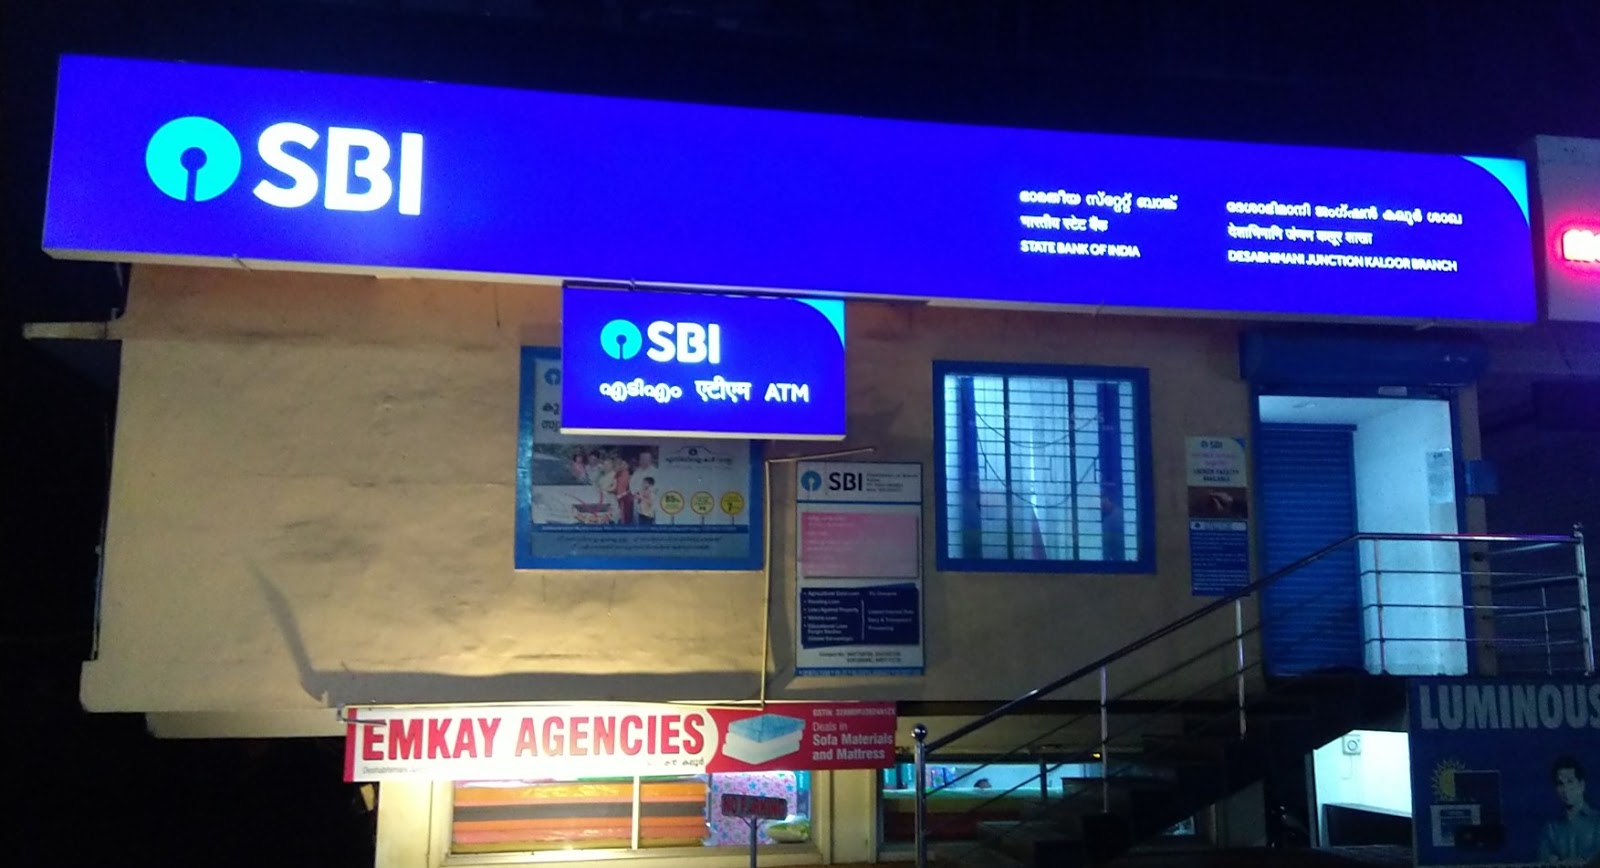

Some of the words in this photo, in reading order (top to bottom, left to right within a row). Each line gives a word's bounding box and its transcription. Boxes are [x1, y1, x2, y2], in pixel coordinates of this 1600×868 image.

[252, 122, 424, 216] SBI
[1019, 213, 1061, 230] भारतीय
[1062, 214, 1087, 231] स्टेट
[1020, 240, 1056, 254] STATE
[1056, 242, 1089, 256] BANK
[1089, 243, 1107, 256] OF
[1108, 244, 1141, 258] INDIA
[1227, 249, 1305, 266] DESABHIMANI
[1305, 252, 1364, 268] JUNCTION
[1364, 255, 1411, 270] KALOOR
[1411, 257, 1458, 273] BRANCH
[646, 320, 721, 365] SBI
[599, 378, 682, 403] എടിഎം
[694, 375, 752, 403] एटीएम
[764, 382, 810, 403] ATM
[829, 472, 862, 491] SBI
[812, 721, 837, 732] Deals
[839, 721, 848, 732] in
[362, 716, 502, 763] EMKAY
[514, 712, 705, 758] AGENCIES
[812, 733, 838, 746] Sofa
[841, 732, 893, 746] Materials
[812, 748, 833, 761] and
[836, 747, 886, 761] Mattress
